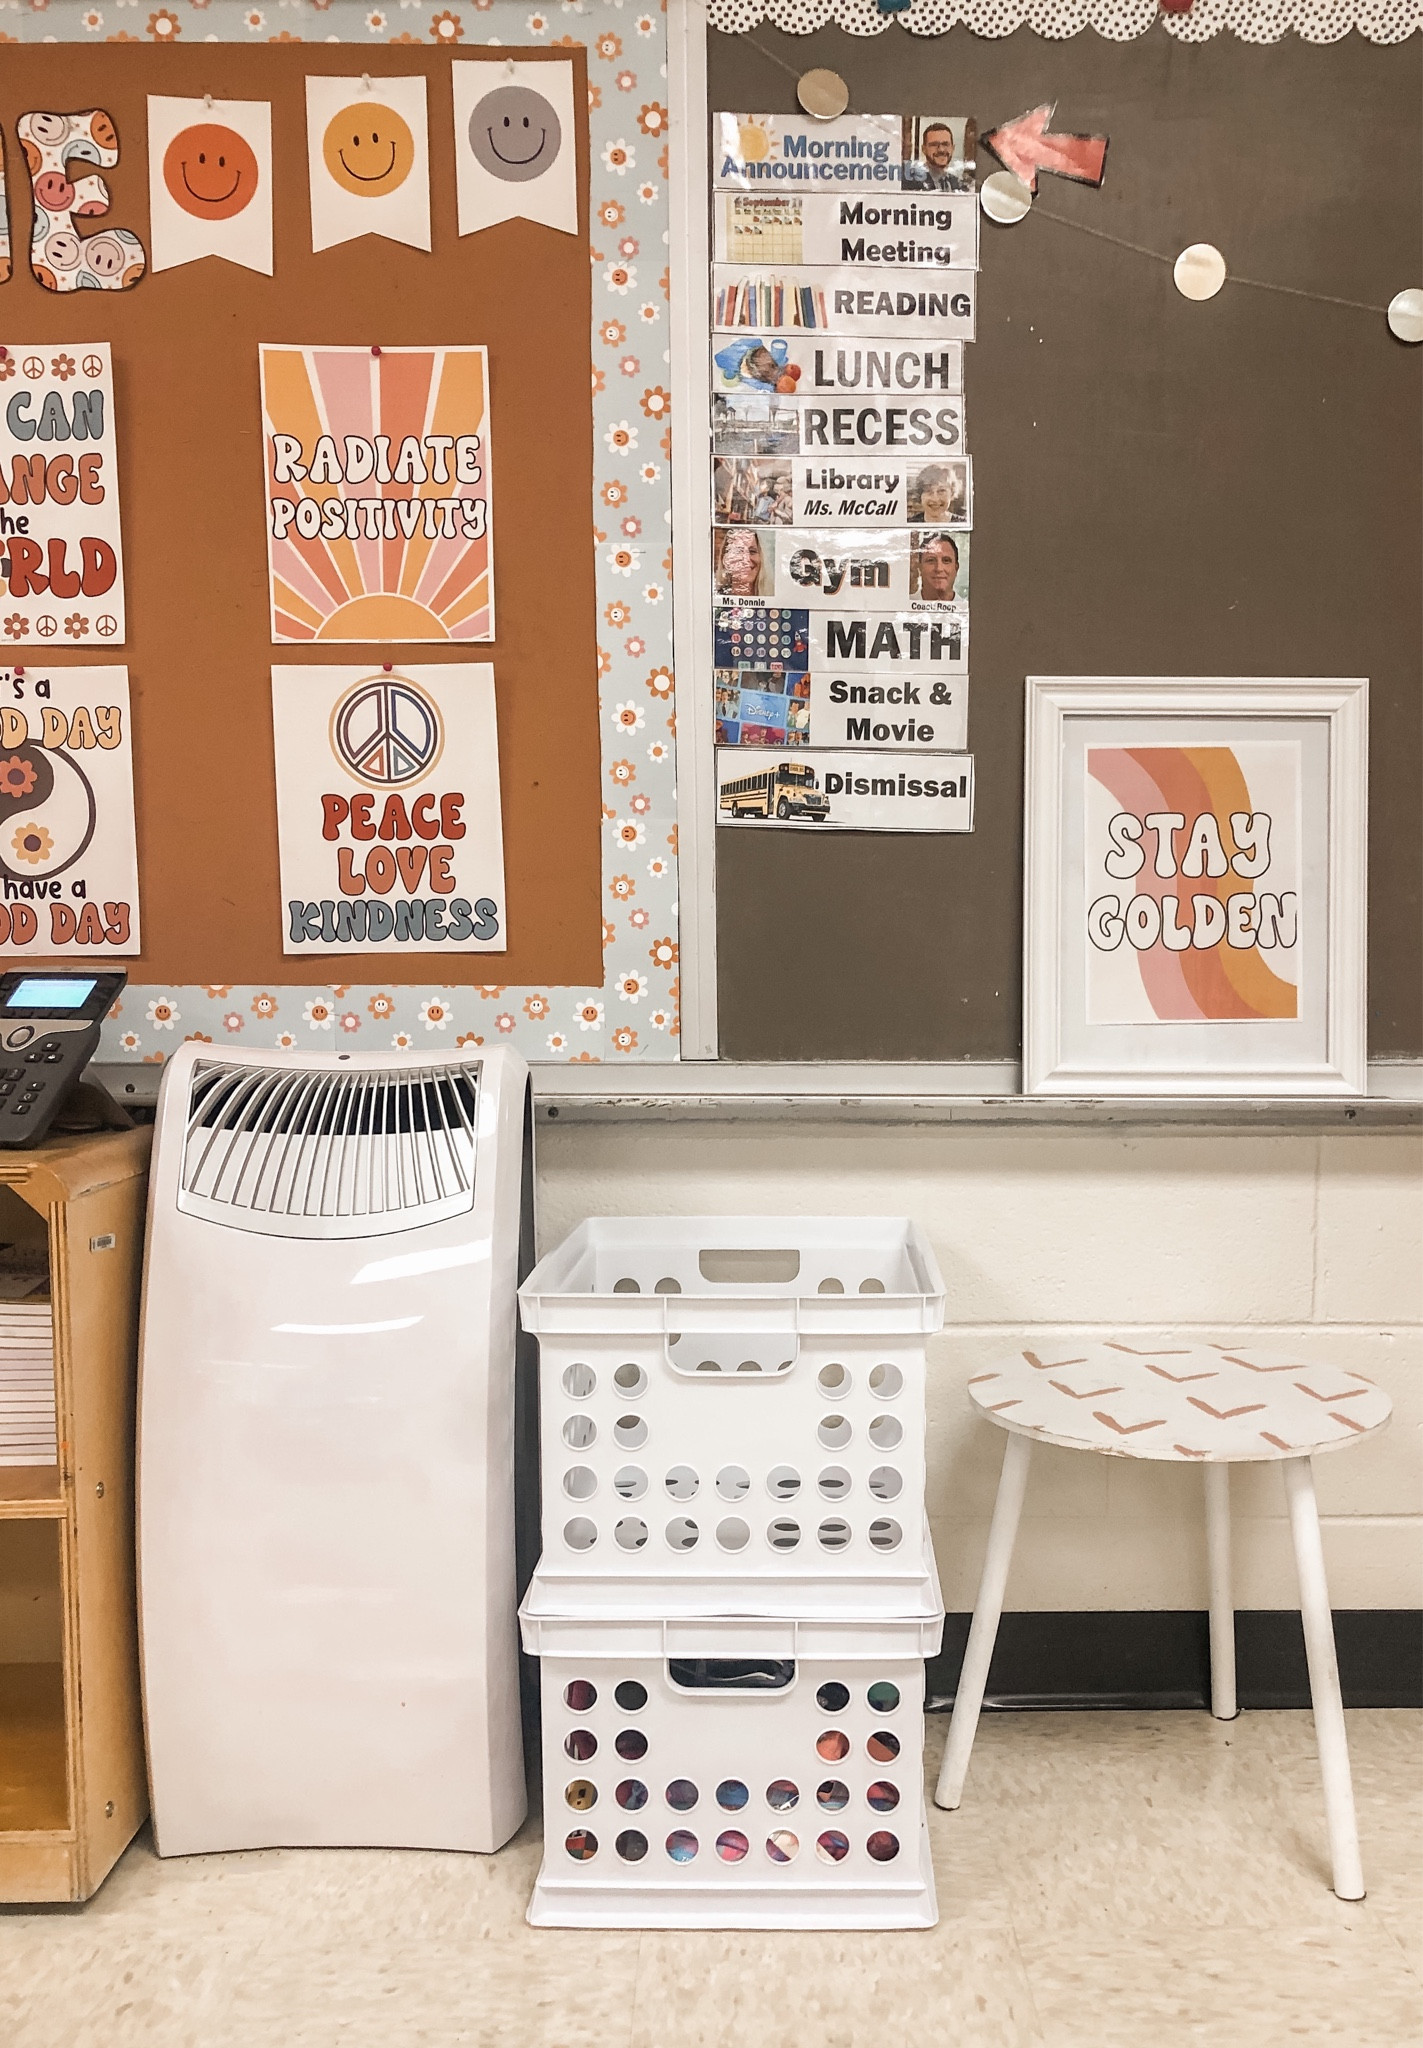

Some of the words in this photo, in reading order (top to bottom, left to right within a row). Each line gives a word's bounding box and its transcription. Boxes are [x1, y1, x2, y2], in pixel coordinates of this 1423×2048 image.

[720, 156, 928, 181] Announcements
[783, 135, 890, 163] Morning
[0, 107, 146, 294] E
[839, 202, 952, 230] Morning
[841, 238, 952, 266] Meeting
[834, 290, 971, 317] READING
[814, 350, 949, 389] LUNCH
[6, 389, 104, 441] CAN
[804, 408, 960, 446] RECESS
[0, 453, 105, 505] NGE
[273, 435, 482, 484] RADIATE
[806, 469, 899, 494] Library
[272, 498, 487, 540] POSITIVITY
[804, 500, 833, 516] Ms.
[838, 500, 898, 516] McCall
[0, 537, 117, 598] RLD
[789, 549, 891, 595] Gym
[722, 598, 736, 606] Ms.
[738, 598, 766, 607] Donnie
[827, 620, 961, 660] MATH
[35, 679, 51, 699] a
[829, 680, 921, 705] Snack
[929, 682, 952, 705] &
[40, 706, 122, 750] DAY
[846, 718, 934, 742] Movie
[825, 772, 967, 798] Dismissal
[321, 792, 467, 841] PEACE
[1105, 812, 1272, 879] STAY
[4, 874, 62, 899] have
[71, 880, 87, 899] a
[337, 845, 457, 896] LOVE
[49, 902, 131, 945] DAY
[289, 898, 499, 943] KINDNESS
[1088, 892, 1298, 951] GOLDEN
